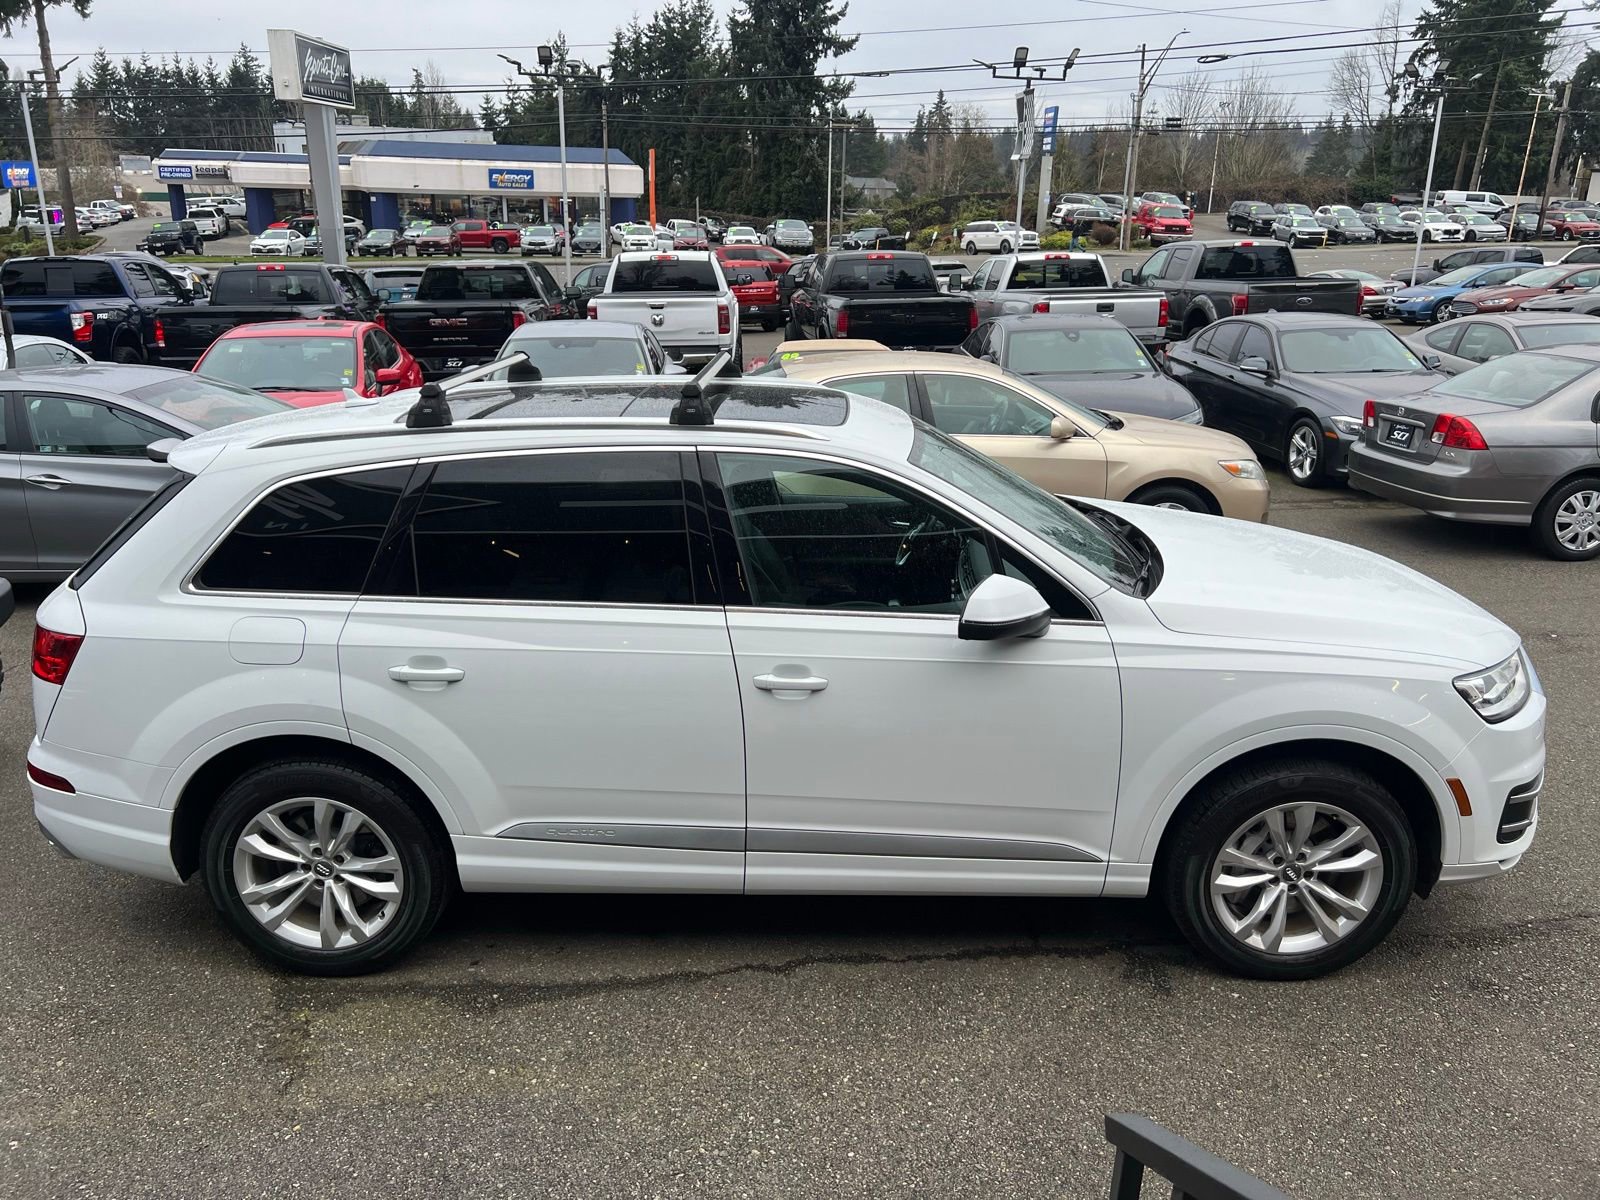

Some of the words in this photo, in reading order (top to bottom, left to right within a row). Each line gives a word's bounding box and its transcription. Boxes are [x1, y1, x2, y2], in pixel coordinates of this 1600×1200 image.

[303, 47, 330, 84] Sports
[308, 85, 348, 101] INTERNATIONAL
[491, 173, 532, 183] ENERGY
[429, 318, 468, 326] GMC
[1391, 430, 1410, 441] SCI
[545, 827, 617, 838] quattro
